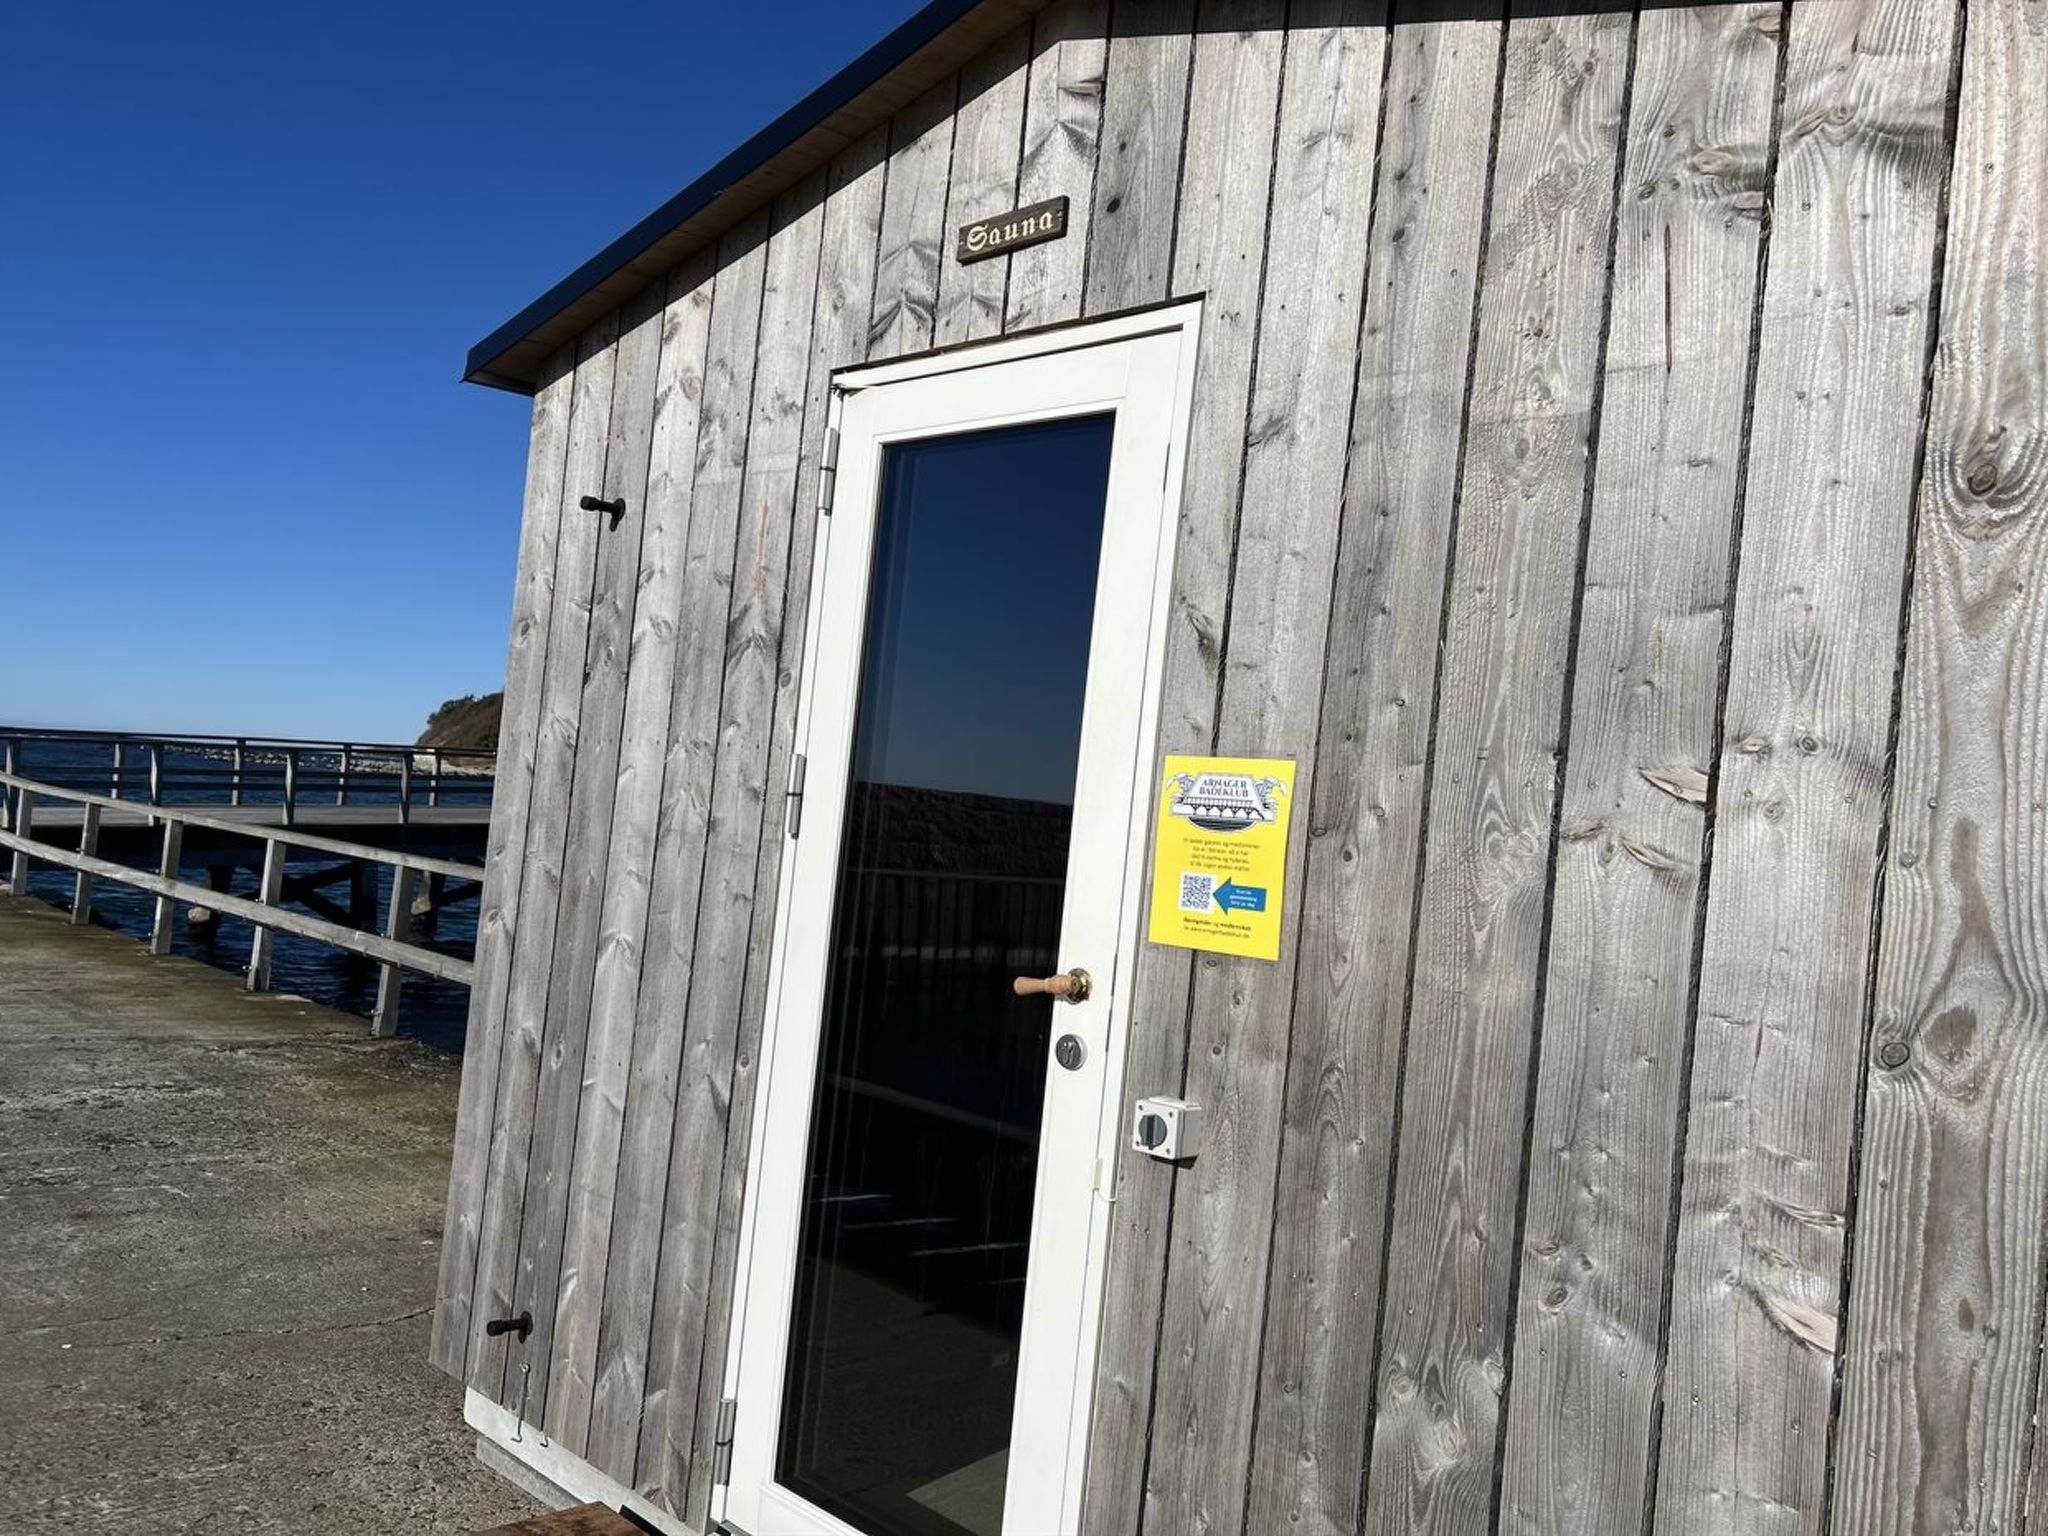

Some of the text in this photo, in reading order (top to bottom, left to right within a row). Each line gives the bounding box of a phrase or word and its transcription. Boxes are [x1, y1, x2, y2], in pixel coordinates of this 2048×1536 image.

[966, 211, 1054, 251] Sauna
[1202, 778, 1247, 789] ARNAGER
[1199, 787, 1249, 798] BADEKLUB
